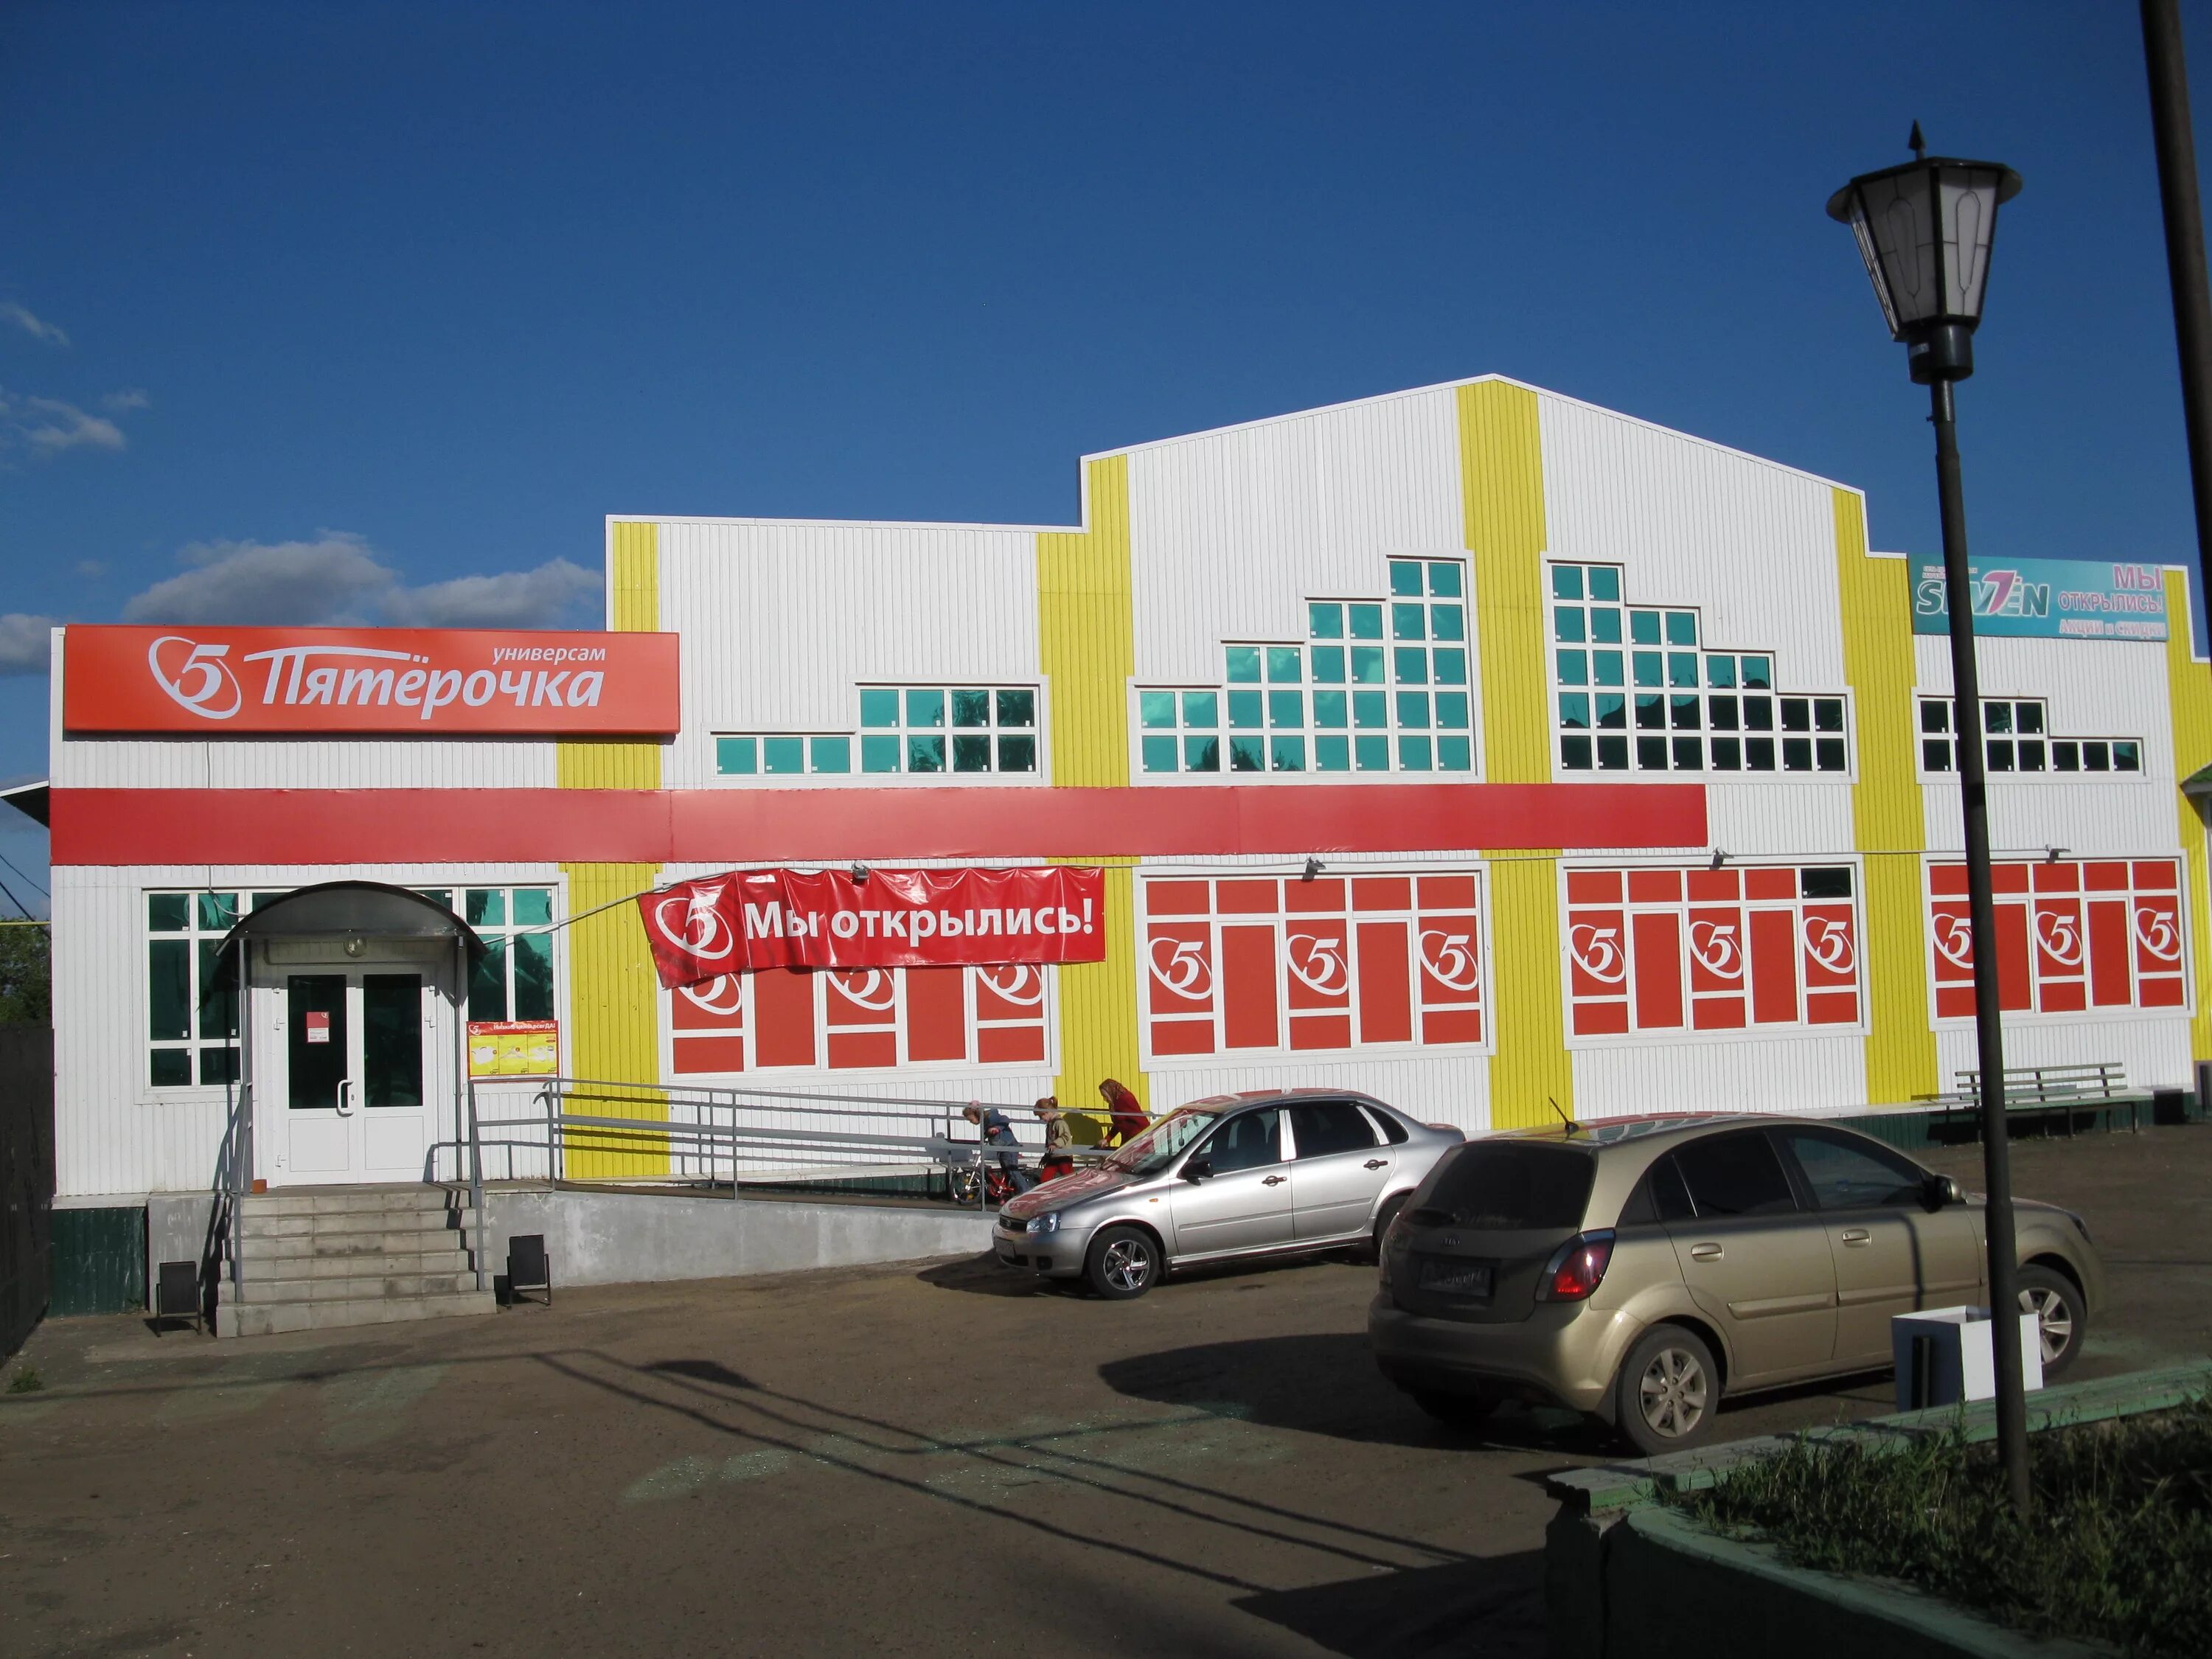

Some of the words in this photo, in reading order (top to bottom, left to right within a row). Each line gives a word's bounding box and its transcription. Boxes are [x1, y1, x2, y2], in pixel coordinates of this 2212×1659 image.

[2113, 564, 2163, 591] МЫ
[2059, 591, 2164, 613] ОТКРЫЛИСЬ!
[492, 647, 606, 665] универсам
[243, 645, 605, 720] Пятёрочка
[744, 900, 818, 939] Мы
[831, 897, 1094, 947] открылись!
